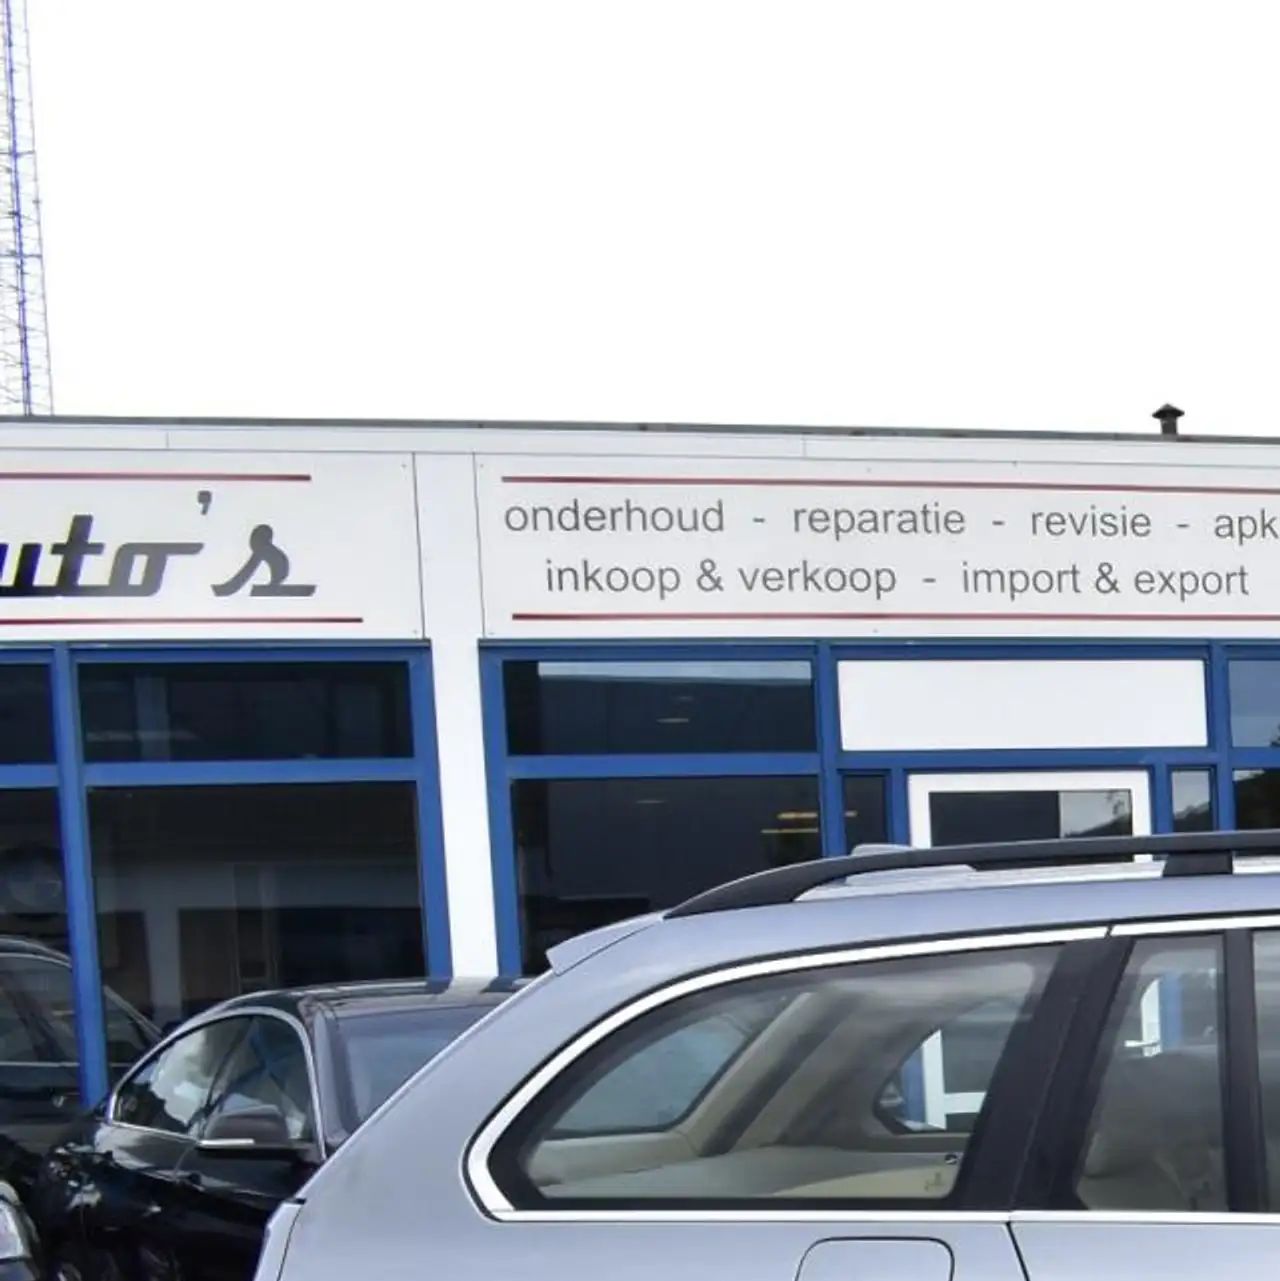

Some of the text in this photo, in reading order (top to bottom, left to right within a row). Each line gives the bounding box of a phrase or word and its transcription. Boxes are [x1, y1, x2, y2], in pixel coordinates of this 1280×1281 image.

[504, 498, 724, 533] onderhoud
[793, 502, 966, 542] reparatie
[1030, 505, 1152, 538] revisie
[1213, 508, 1280, 546] apk
[545, 559, 682, 601] inkoop
[695, 558, 725, 593] &
[737, 559, 897, 601] verkoop
[962, 561, 1082, 602] import
[1093, 562, 1121, 595] &
[1133, 565, 1250, 603] export
